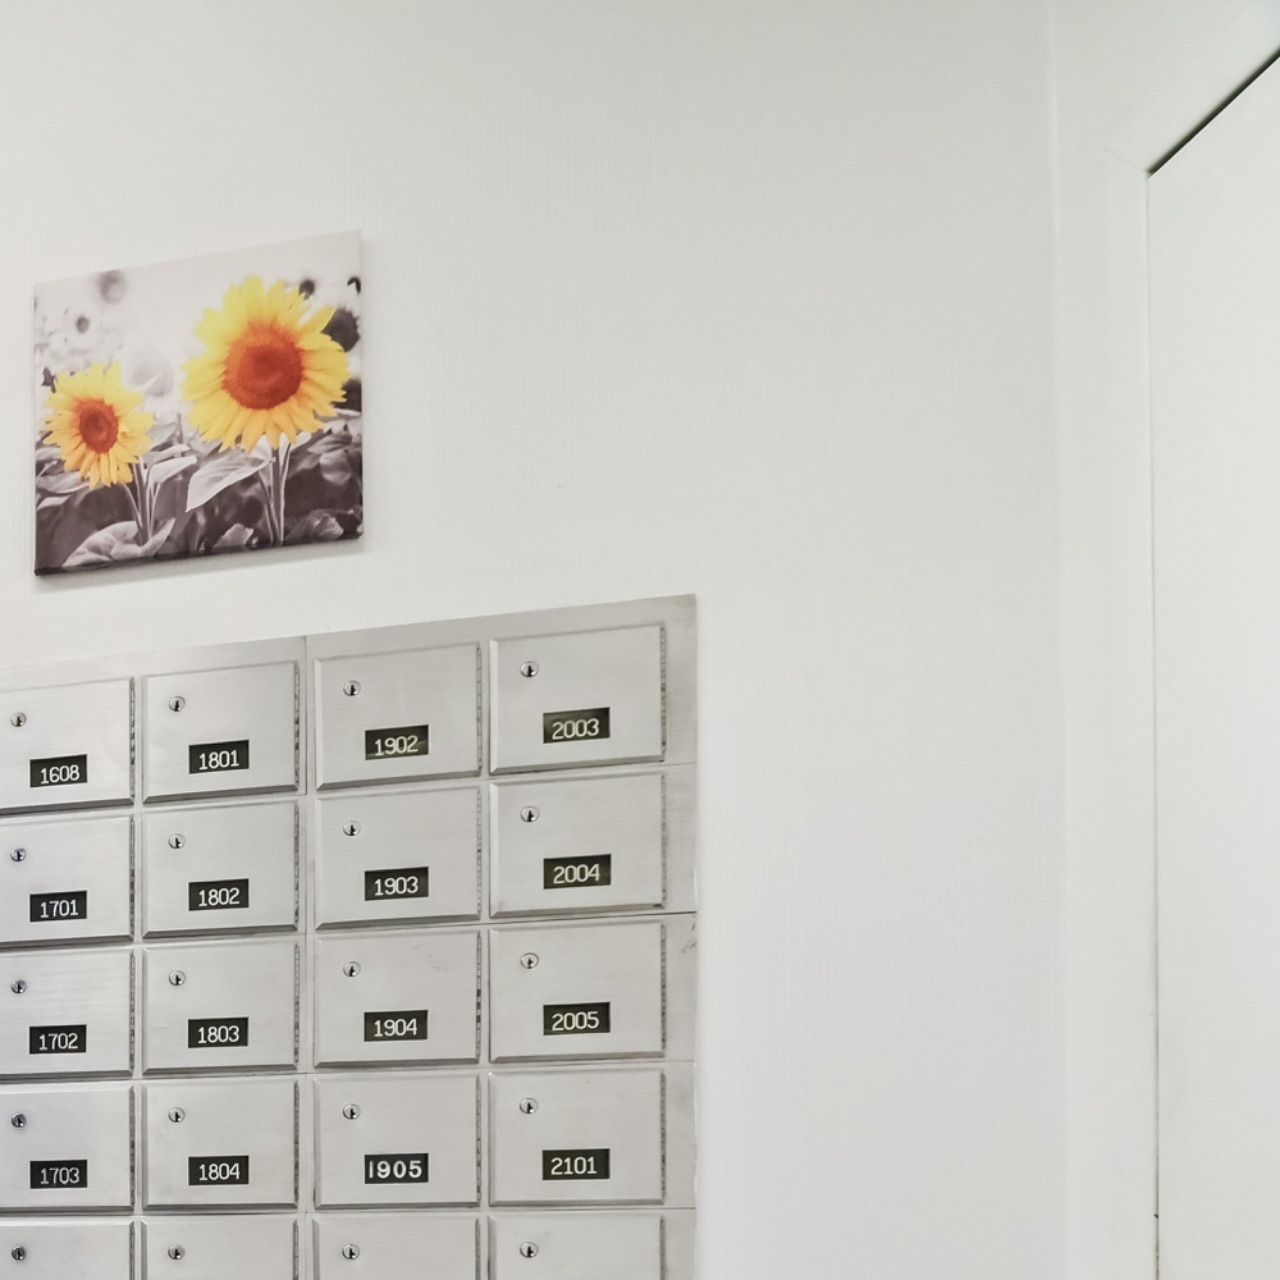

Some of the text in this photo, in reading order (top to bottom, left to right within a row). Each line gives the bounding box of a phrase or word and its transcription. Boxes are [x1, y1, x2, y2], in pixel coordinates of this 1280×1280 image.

[552, 718, 599, 738] 2003
[375, 735, 418, 755] 1902
[200, 750, 239, 769] 1801
[41, 765, 80, 783] 1608
[554, 864, 599, 885] 2004
[375, 876, 418, 896] 1903
[199, 888, 239, 907] 1802
[41, 900, 78, 917] 1701
[375, 1019, 417, 1038] 1904
[552, 1011, 599, 1031] 2005
[40, 1033, 78, 1050] 1702
[198, 1025, 239, 1044] 1803
[41, 1167, 79, 1185] 1703
[200, 1163, 239, 1181] 1804
[369, 1161, 422, 1179] 1905
[551, 1157, 596, 1176] 2101
